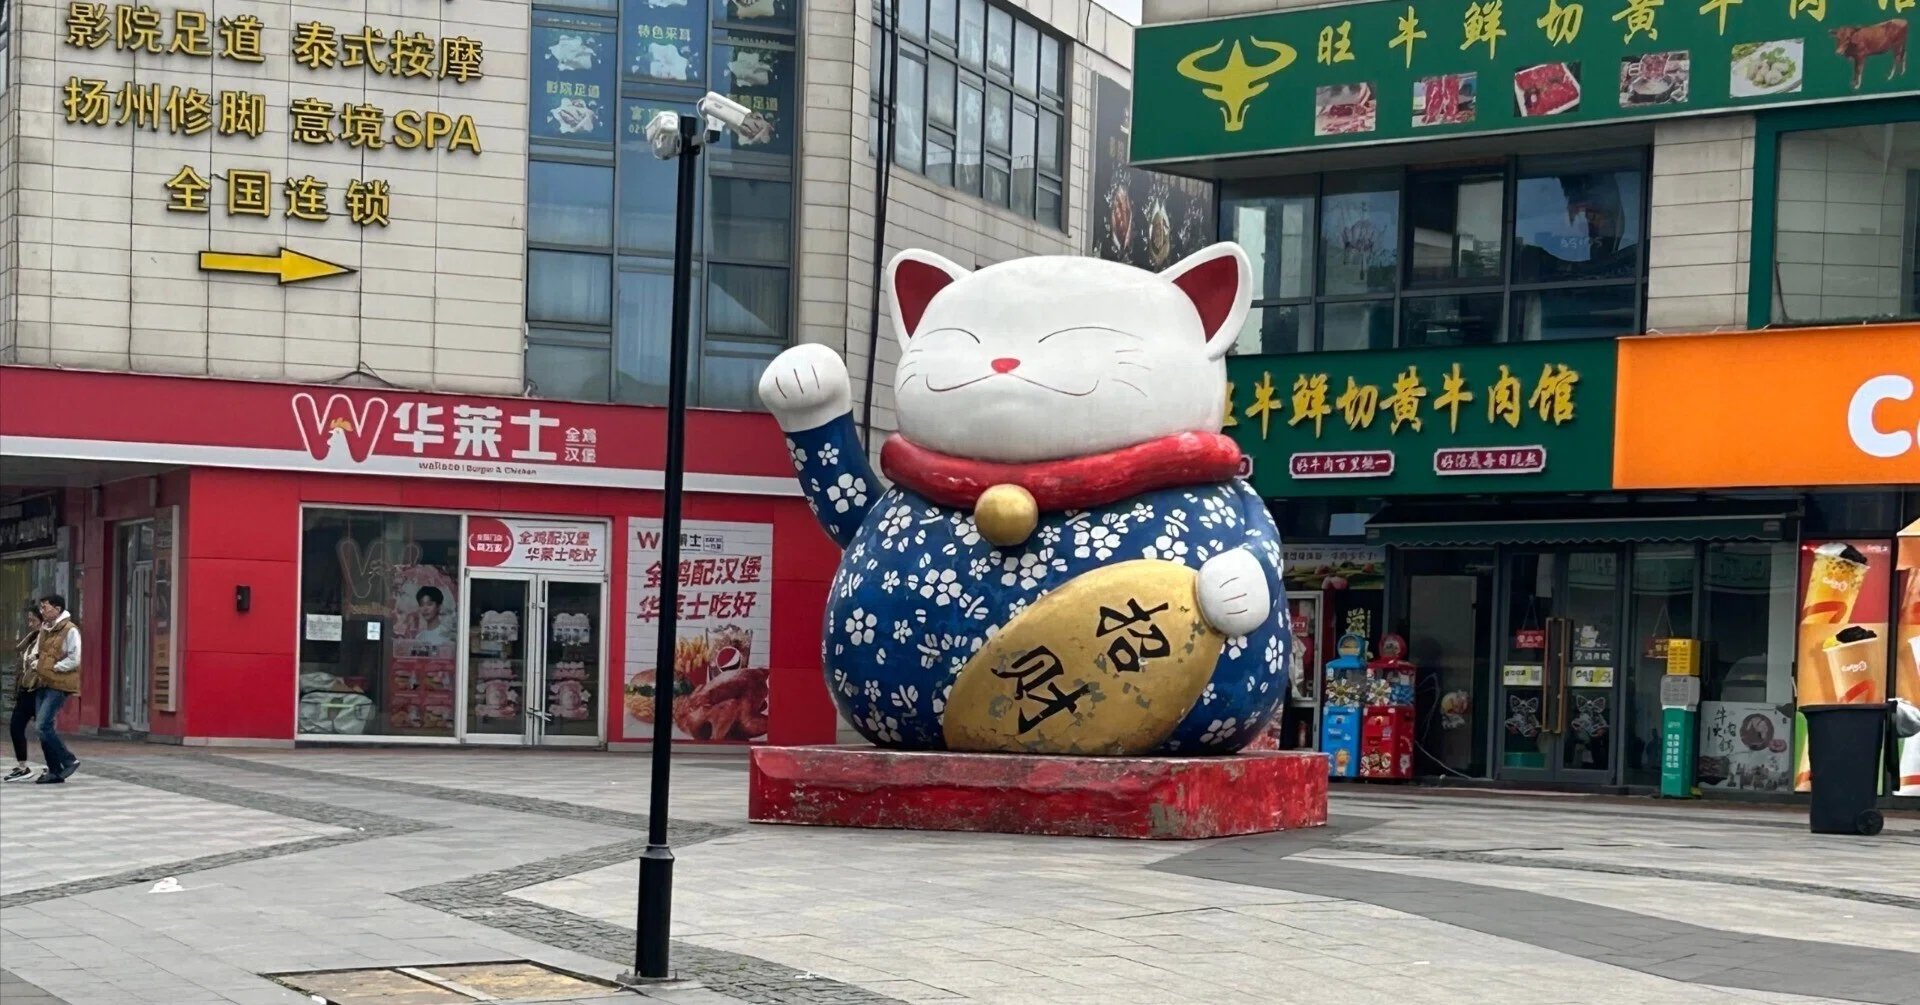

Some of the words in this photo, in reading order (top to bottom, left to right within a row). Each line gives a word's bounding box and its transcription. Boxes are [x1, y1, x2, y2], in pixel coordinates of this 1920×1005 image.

[64, 1, 266, 63] 影院足道
[292, 21, 484, 85] 泰式按摩
[63, 75, 267, 138] 扬州修脚
[289, 96, 483, 155] 意境SPA
[165, 163, 391, 228] 全国连锁
[393, 402, 560, 461] 华莱士
[564, 446, 596, 463] 汉堡
[565, 427, 597, 444] 全鸡
[517, 530, 590, 546] 全鸡配汉堡
[525, 547, 598, 562] 华莱士吃好
[991, 598, 1170, 735] 招财
